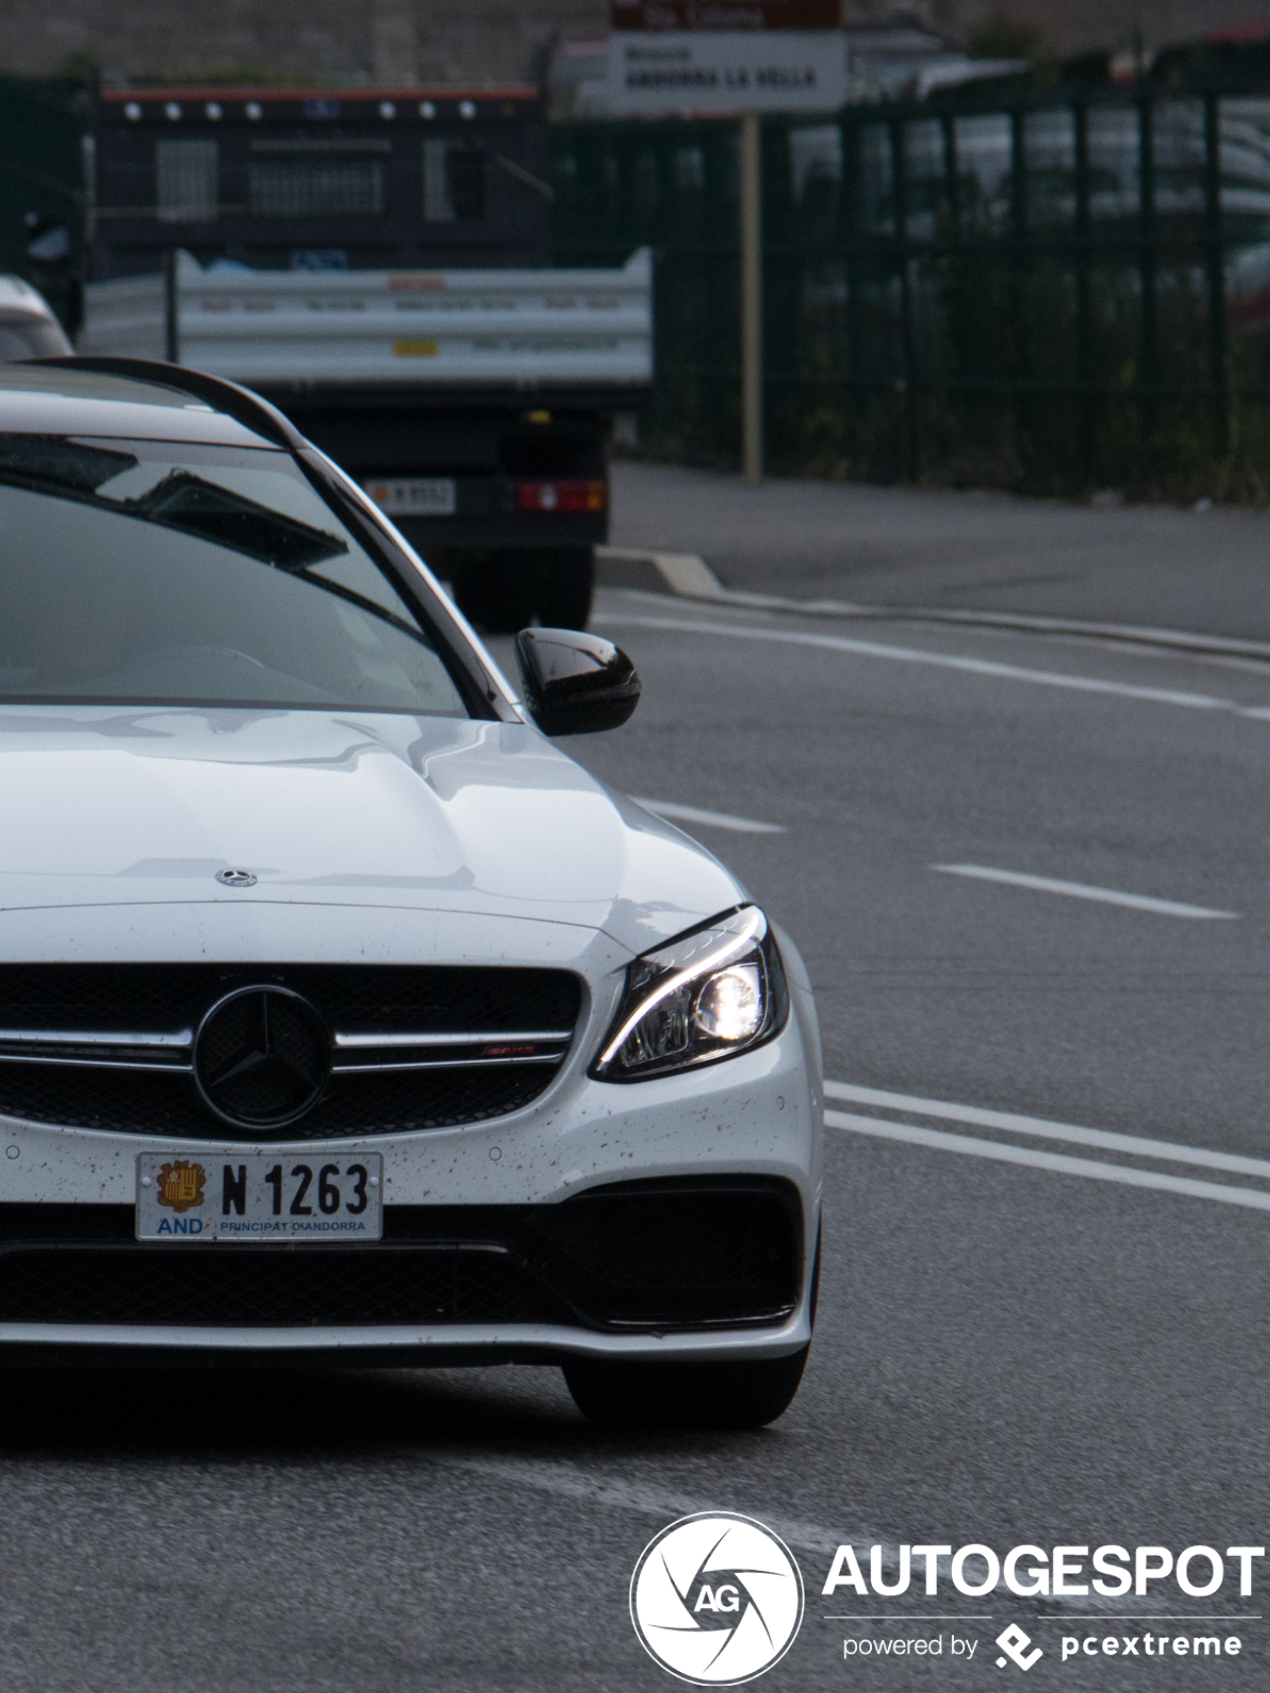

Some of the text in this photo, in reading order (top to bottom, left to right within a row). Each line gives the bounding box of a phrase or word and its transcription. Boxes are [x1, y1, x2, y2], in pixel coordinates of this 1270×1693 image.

[222, 1163, 368, 1216] N 1263
[157, 1217, 204, 1235] AND
[220, 1221, 288, 1232] PRINCIPAT
